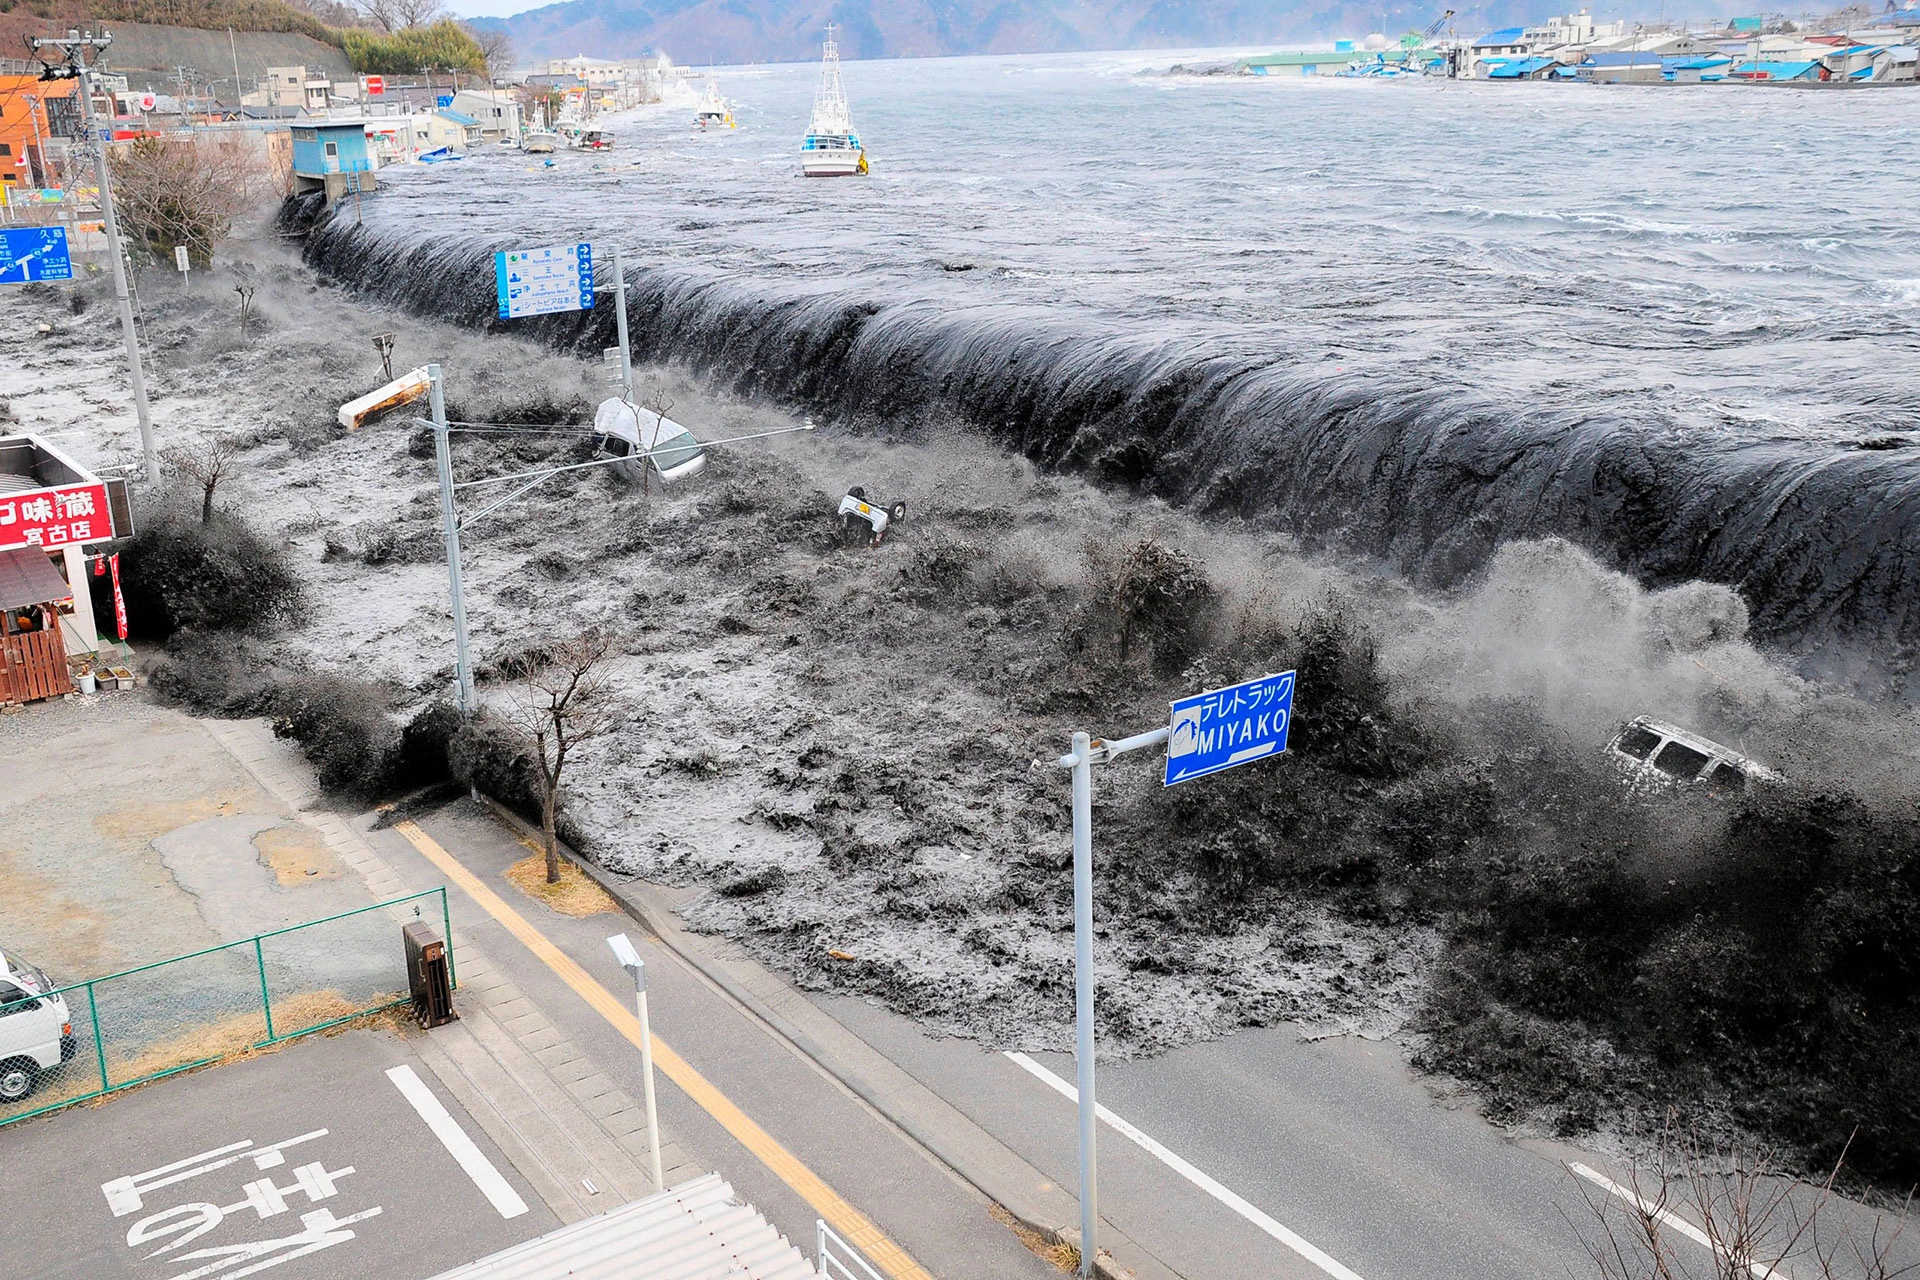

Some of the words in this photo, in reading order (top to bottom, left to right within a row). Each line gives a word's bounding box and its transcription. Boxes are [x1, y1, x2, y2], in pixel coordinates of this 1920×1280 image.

[23, 520, 91, 546] 宮古店
[1202, 676, 1292, 723] テレトラック
[1197, 708, 1287, 756] MIYAKO
